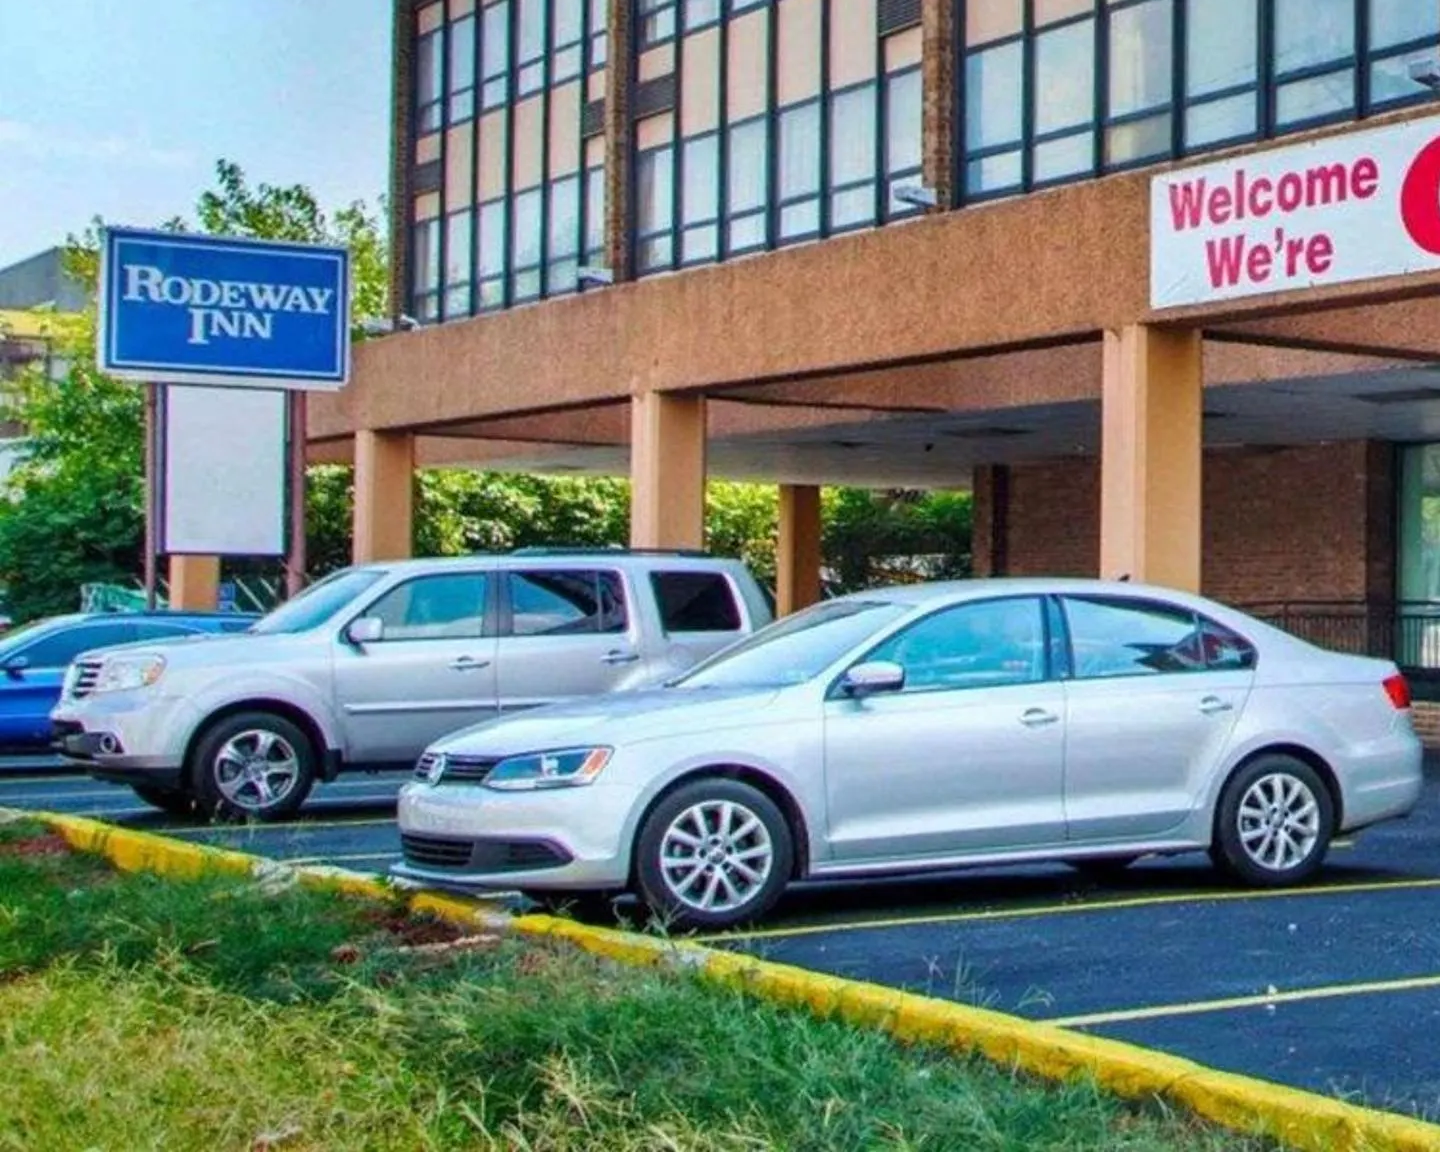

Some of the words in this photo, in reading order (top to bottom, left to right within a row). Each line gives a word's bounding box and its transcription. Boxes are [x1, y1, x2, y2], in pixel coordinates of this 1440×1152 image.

[1168, 156, 1380, 233] Welcome
[1206, 225, 1334, 288] We're
[122, 263, 334, 315] RODEWAY
[187, 308, 272, 345] INN
